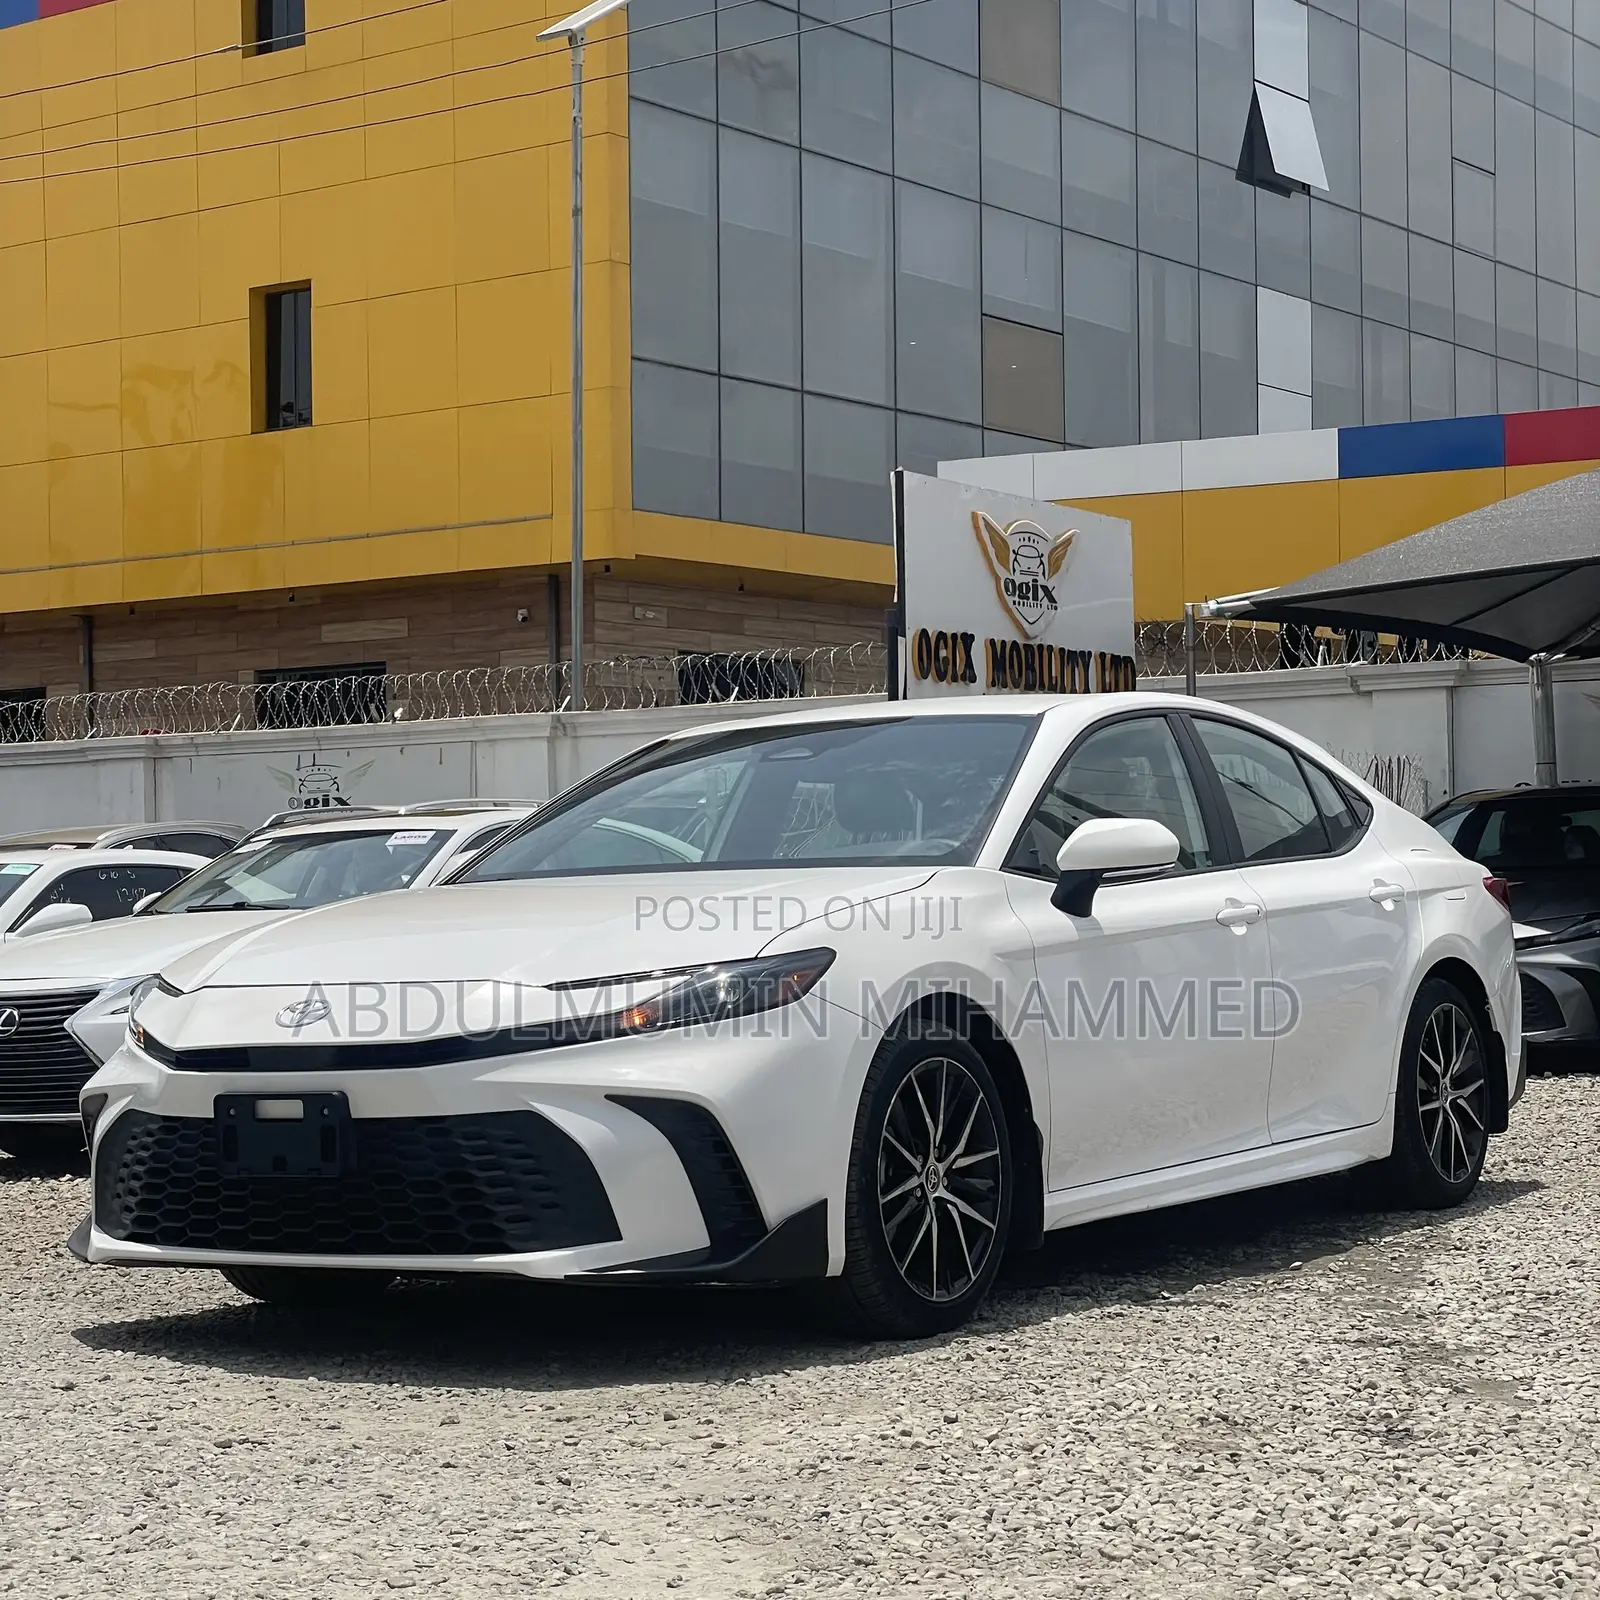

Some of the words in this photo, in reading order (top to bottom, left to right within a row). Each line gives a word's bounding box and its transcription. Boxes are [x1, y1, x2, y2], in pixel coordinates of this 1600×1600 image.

[1012, 600, 1043, 609] MOBILITY
[913, 627, 977, 684] OGIX
[984, 637, 1093, 694] MOBILITY
[1094, 650, 1137, 694] LTD
